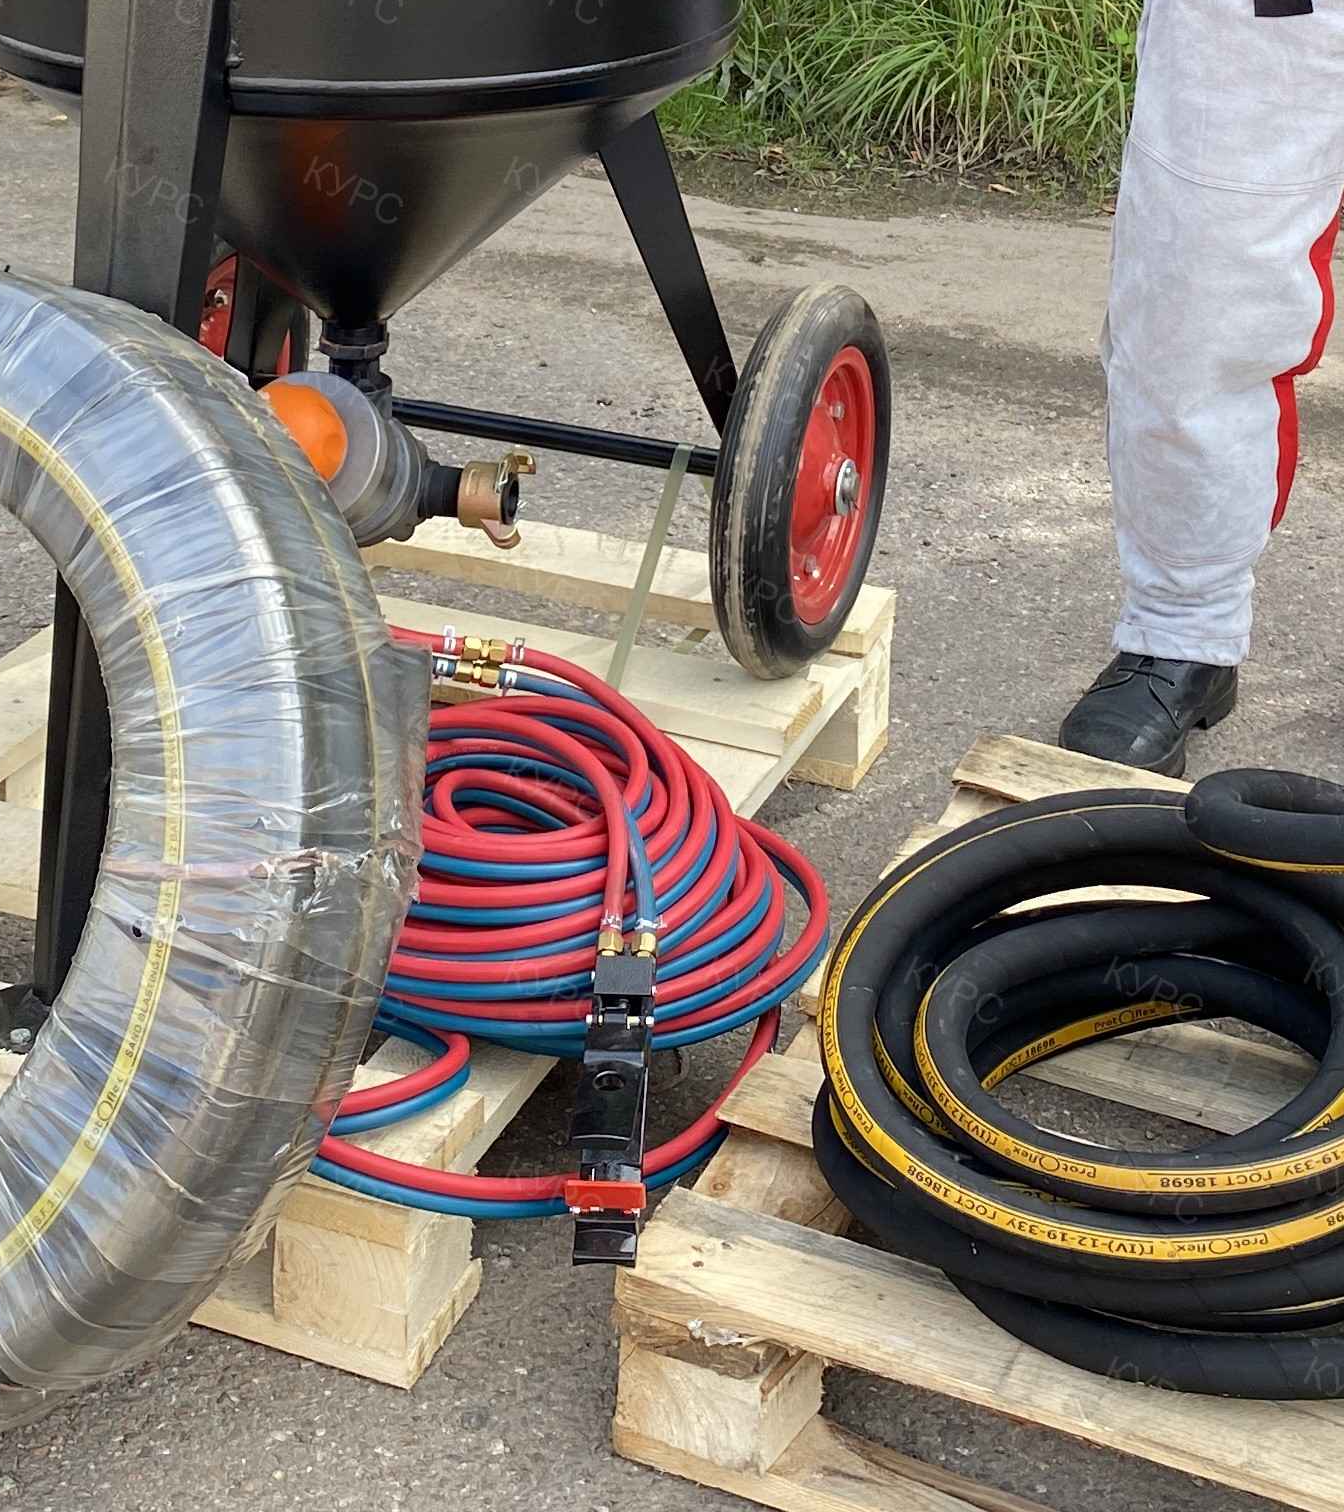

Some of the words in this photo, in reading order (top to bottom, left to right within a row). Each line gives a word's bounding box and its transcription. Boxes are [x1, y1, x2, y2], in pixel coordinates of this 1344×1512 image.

[124, 1023, 146, 1059] SAND
[906, 1165, 951, 1198] 18698
[1160, 1176, 1217, 1189] 18698
[1227, 1172, 1272, 1186] ГОСТ
[955, 1193, 997, 1220] ГОСТ
